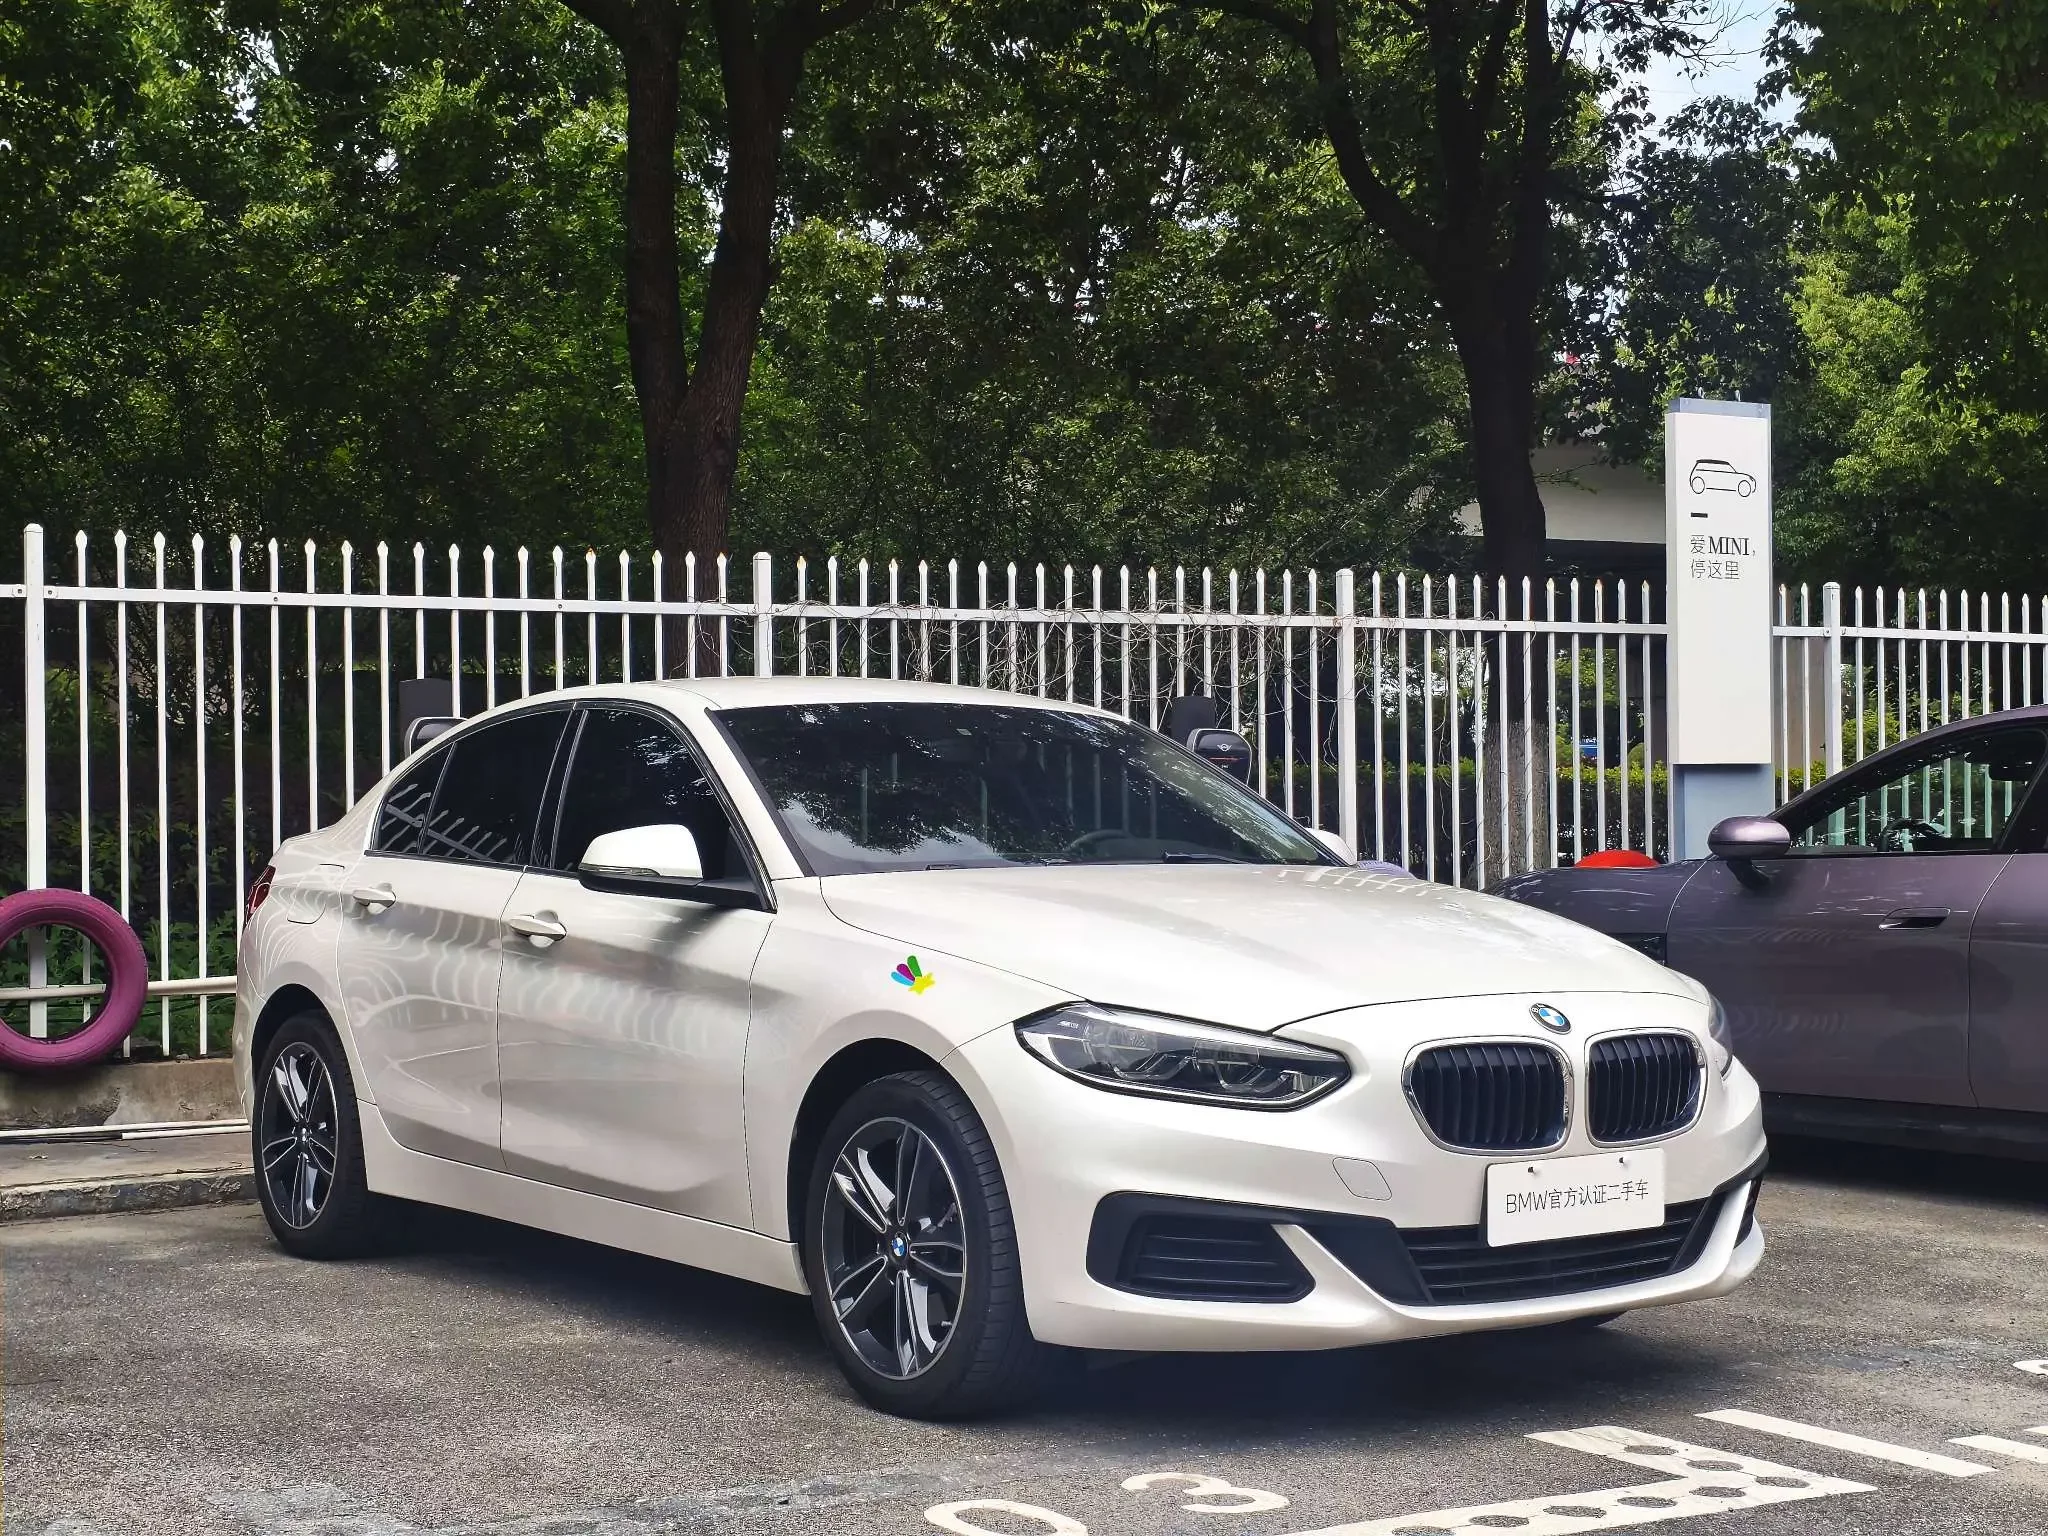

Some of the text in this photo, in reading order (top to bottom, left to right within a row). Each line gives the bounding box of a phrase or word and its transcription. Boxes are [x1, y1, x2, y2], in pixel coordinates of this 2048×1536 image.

[1690, 558, 1741, 580] 停这里
[1506, 1178, 1649, 1214] BMW官方认证二手车
